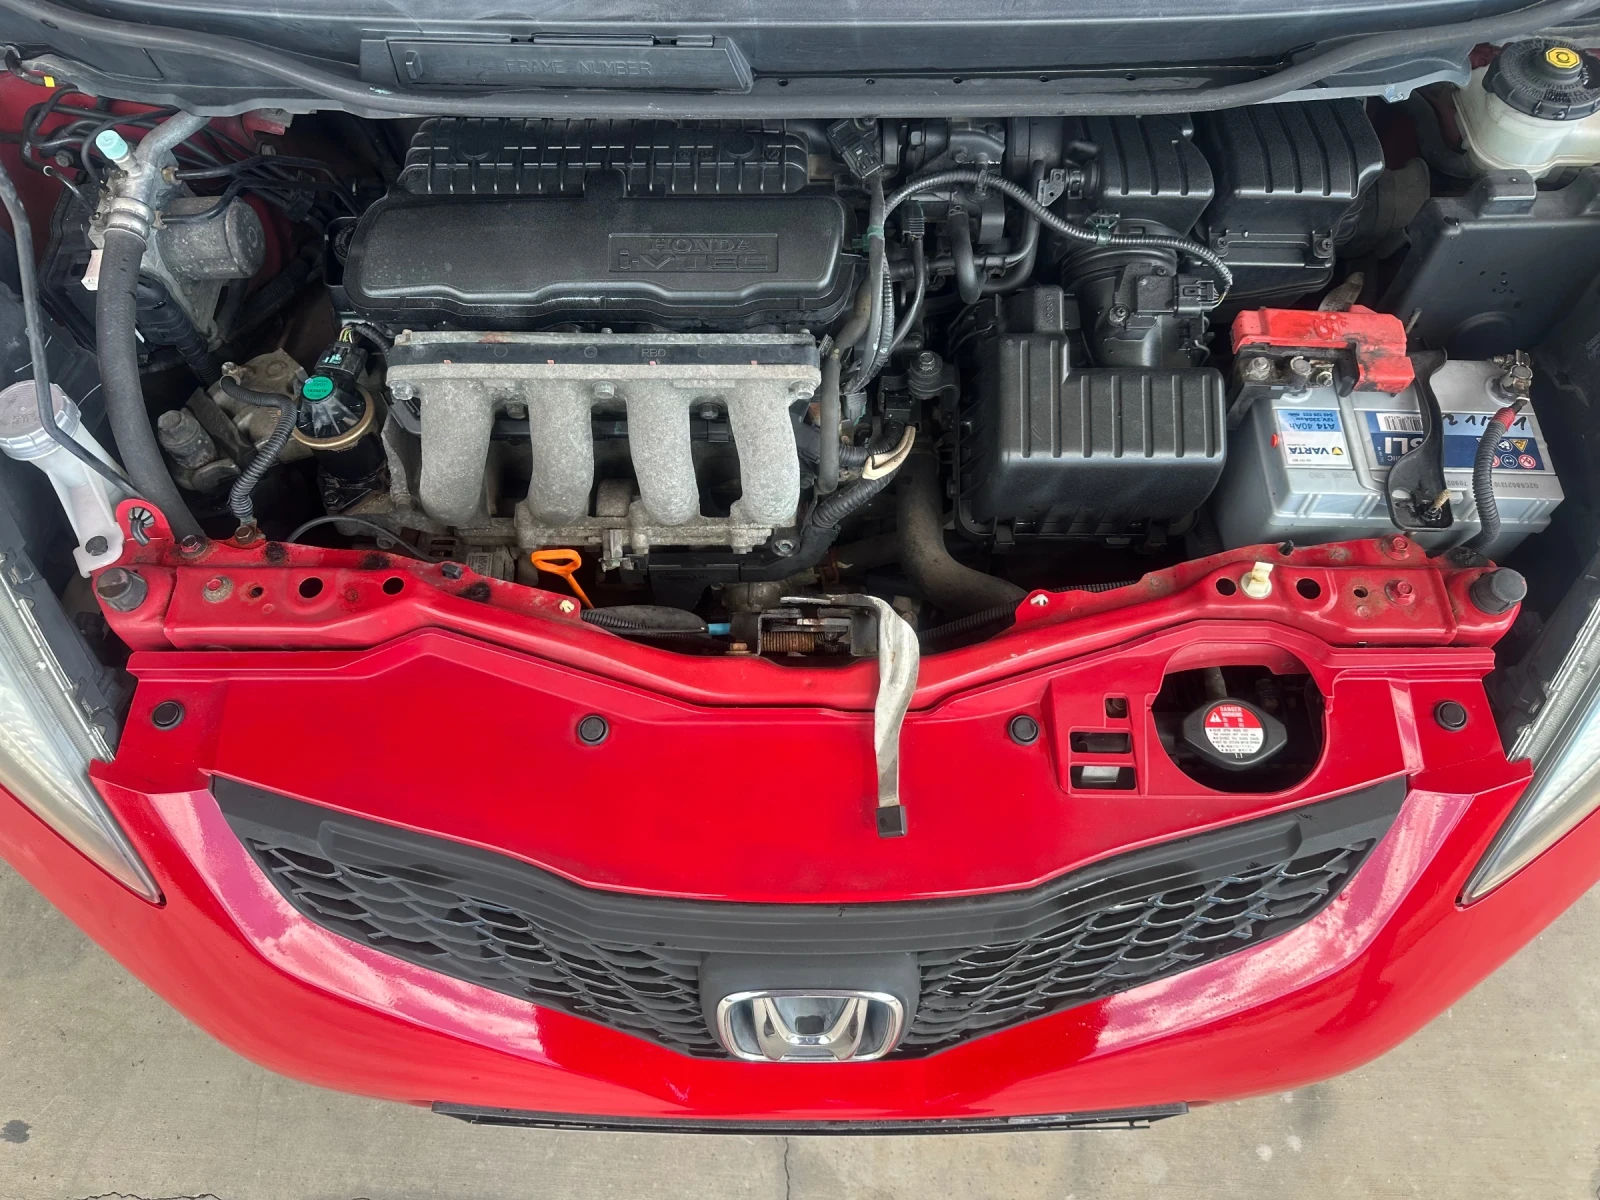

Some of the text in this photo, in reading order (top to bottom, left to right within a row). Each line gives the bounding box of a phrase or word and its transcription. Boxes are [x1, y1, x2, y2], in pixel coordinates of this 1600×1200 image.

[505, 59, 652, 75] FRAME NUMBER
[649, 238, 756, 253] HONDA
[619, 249, 768, 270] i-VTEC
[1289, 422, 1313, 430] 40Ah
[1288, 447, 1330, 455] VARTA
